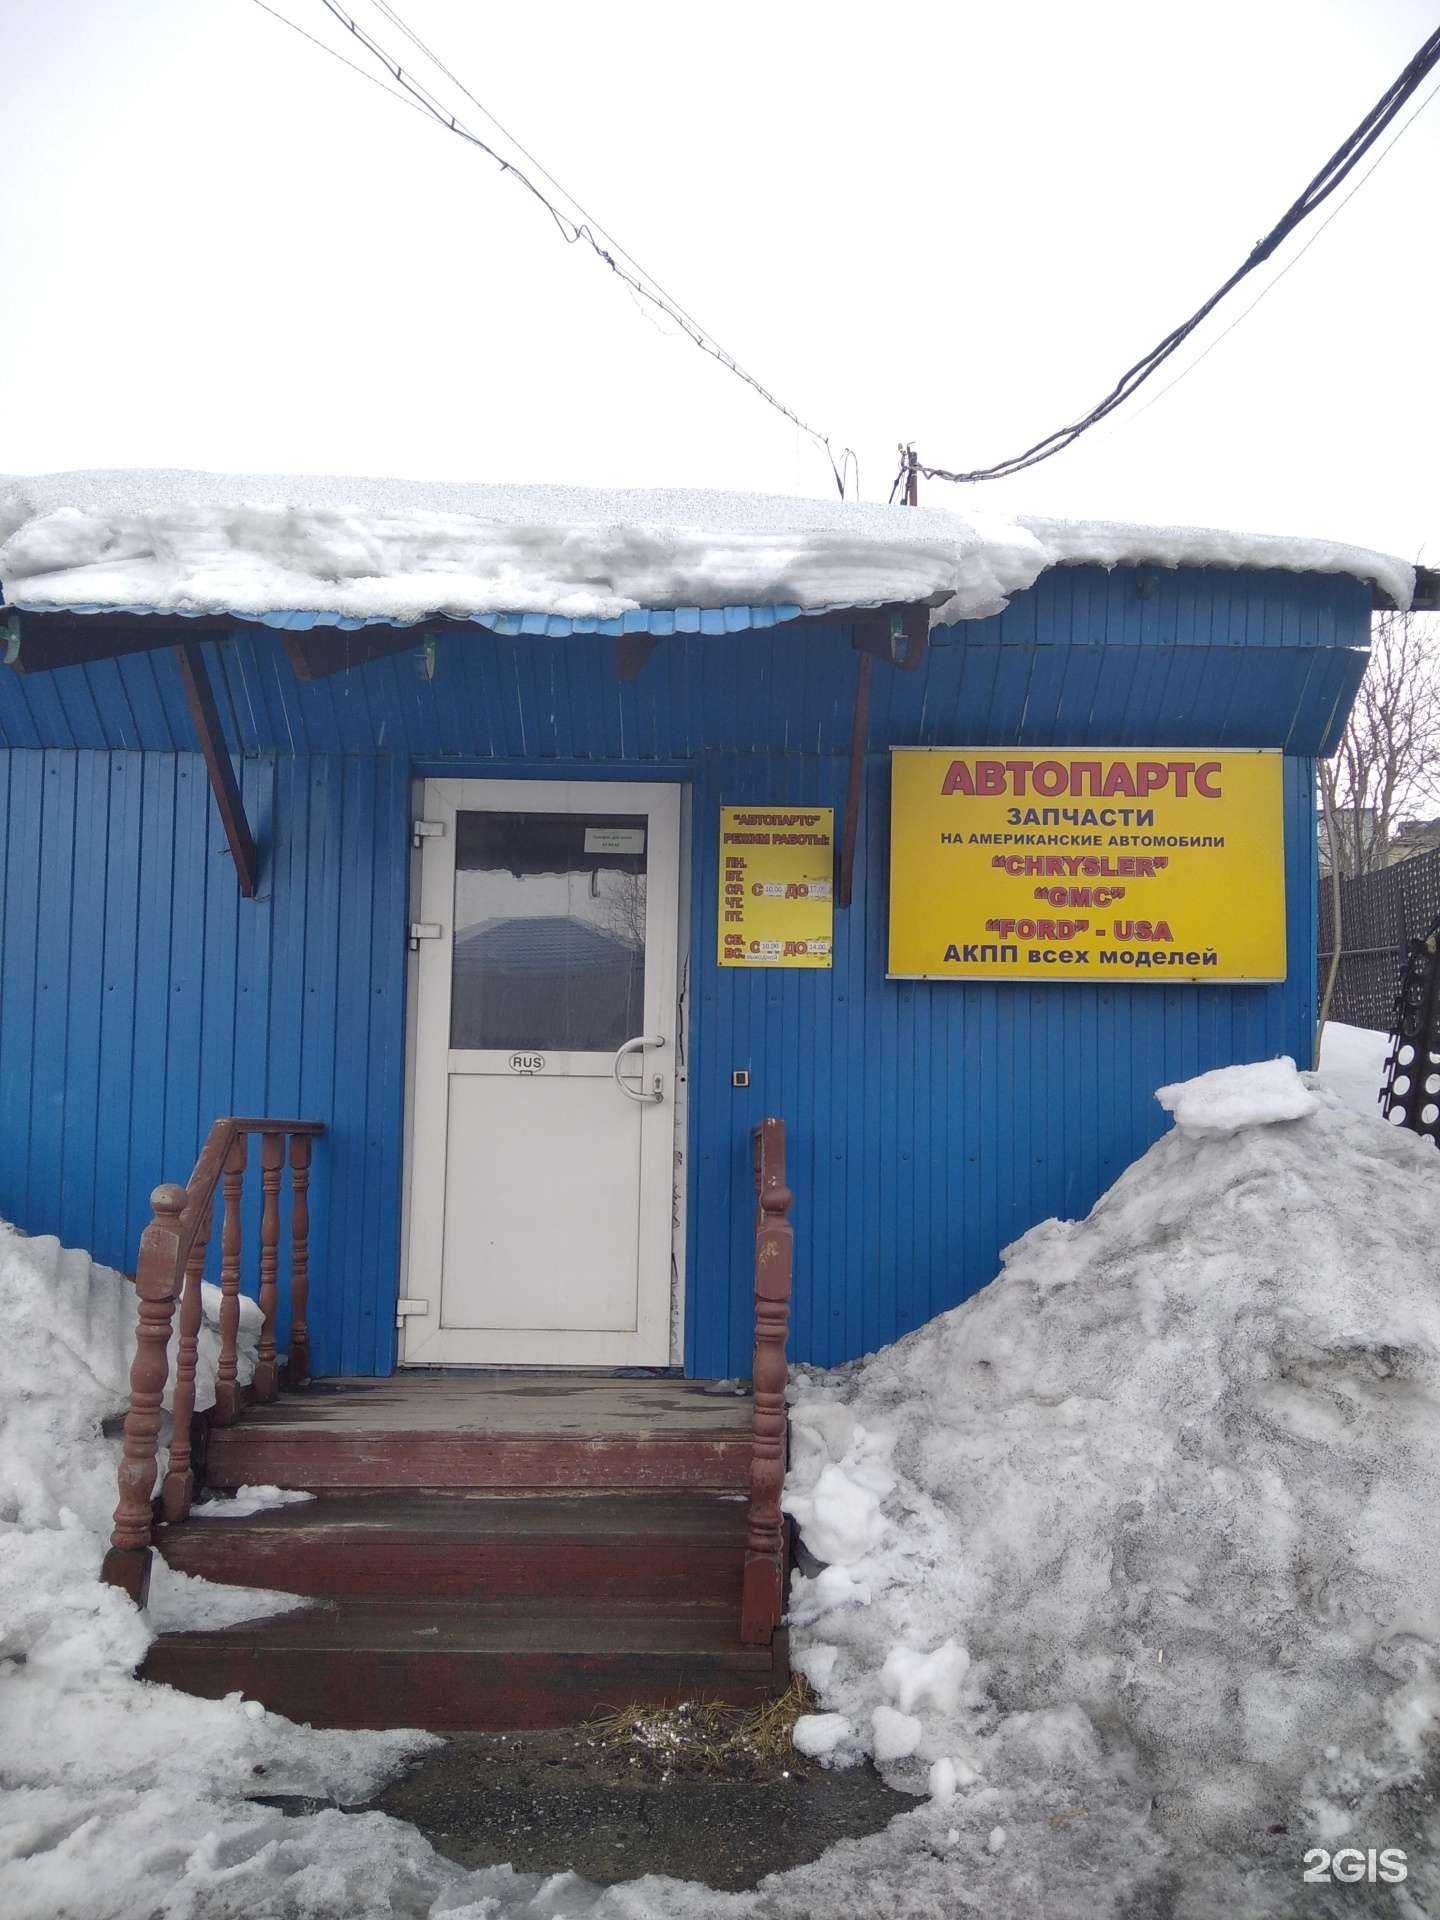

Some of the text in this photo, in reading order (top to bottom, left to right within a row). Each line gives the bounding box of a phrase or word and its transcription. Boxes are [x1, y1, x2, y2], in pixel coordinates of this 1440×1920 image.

[941, 760, 1222, 798] АВТОПАРТС
[1007, 807, 1154, 827] ЗАПЧАСТИ
[723, 833, 770, 845] РЕЖИМ
[941, 833, 1225, 848] НА АМЕРИКАНСКИЕ АВТОМОБИЛИ
[752, 883, 764, 897] С
[785, 884, 809, 899] ДО
[1113, 920, 1174, 942] USA
[750, 941, 761, 953] С
[783, 941, 807, 956] ДО
[943, 945, 1218, 967] АКПП всех моделей
[513, 1056, 542, 1068] RUS
